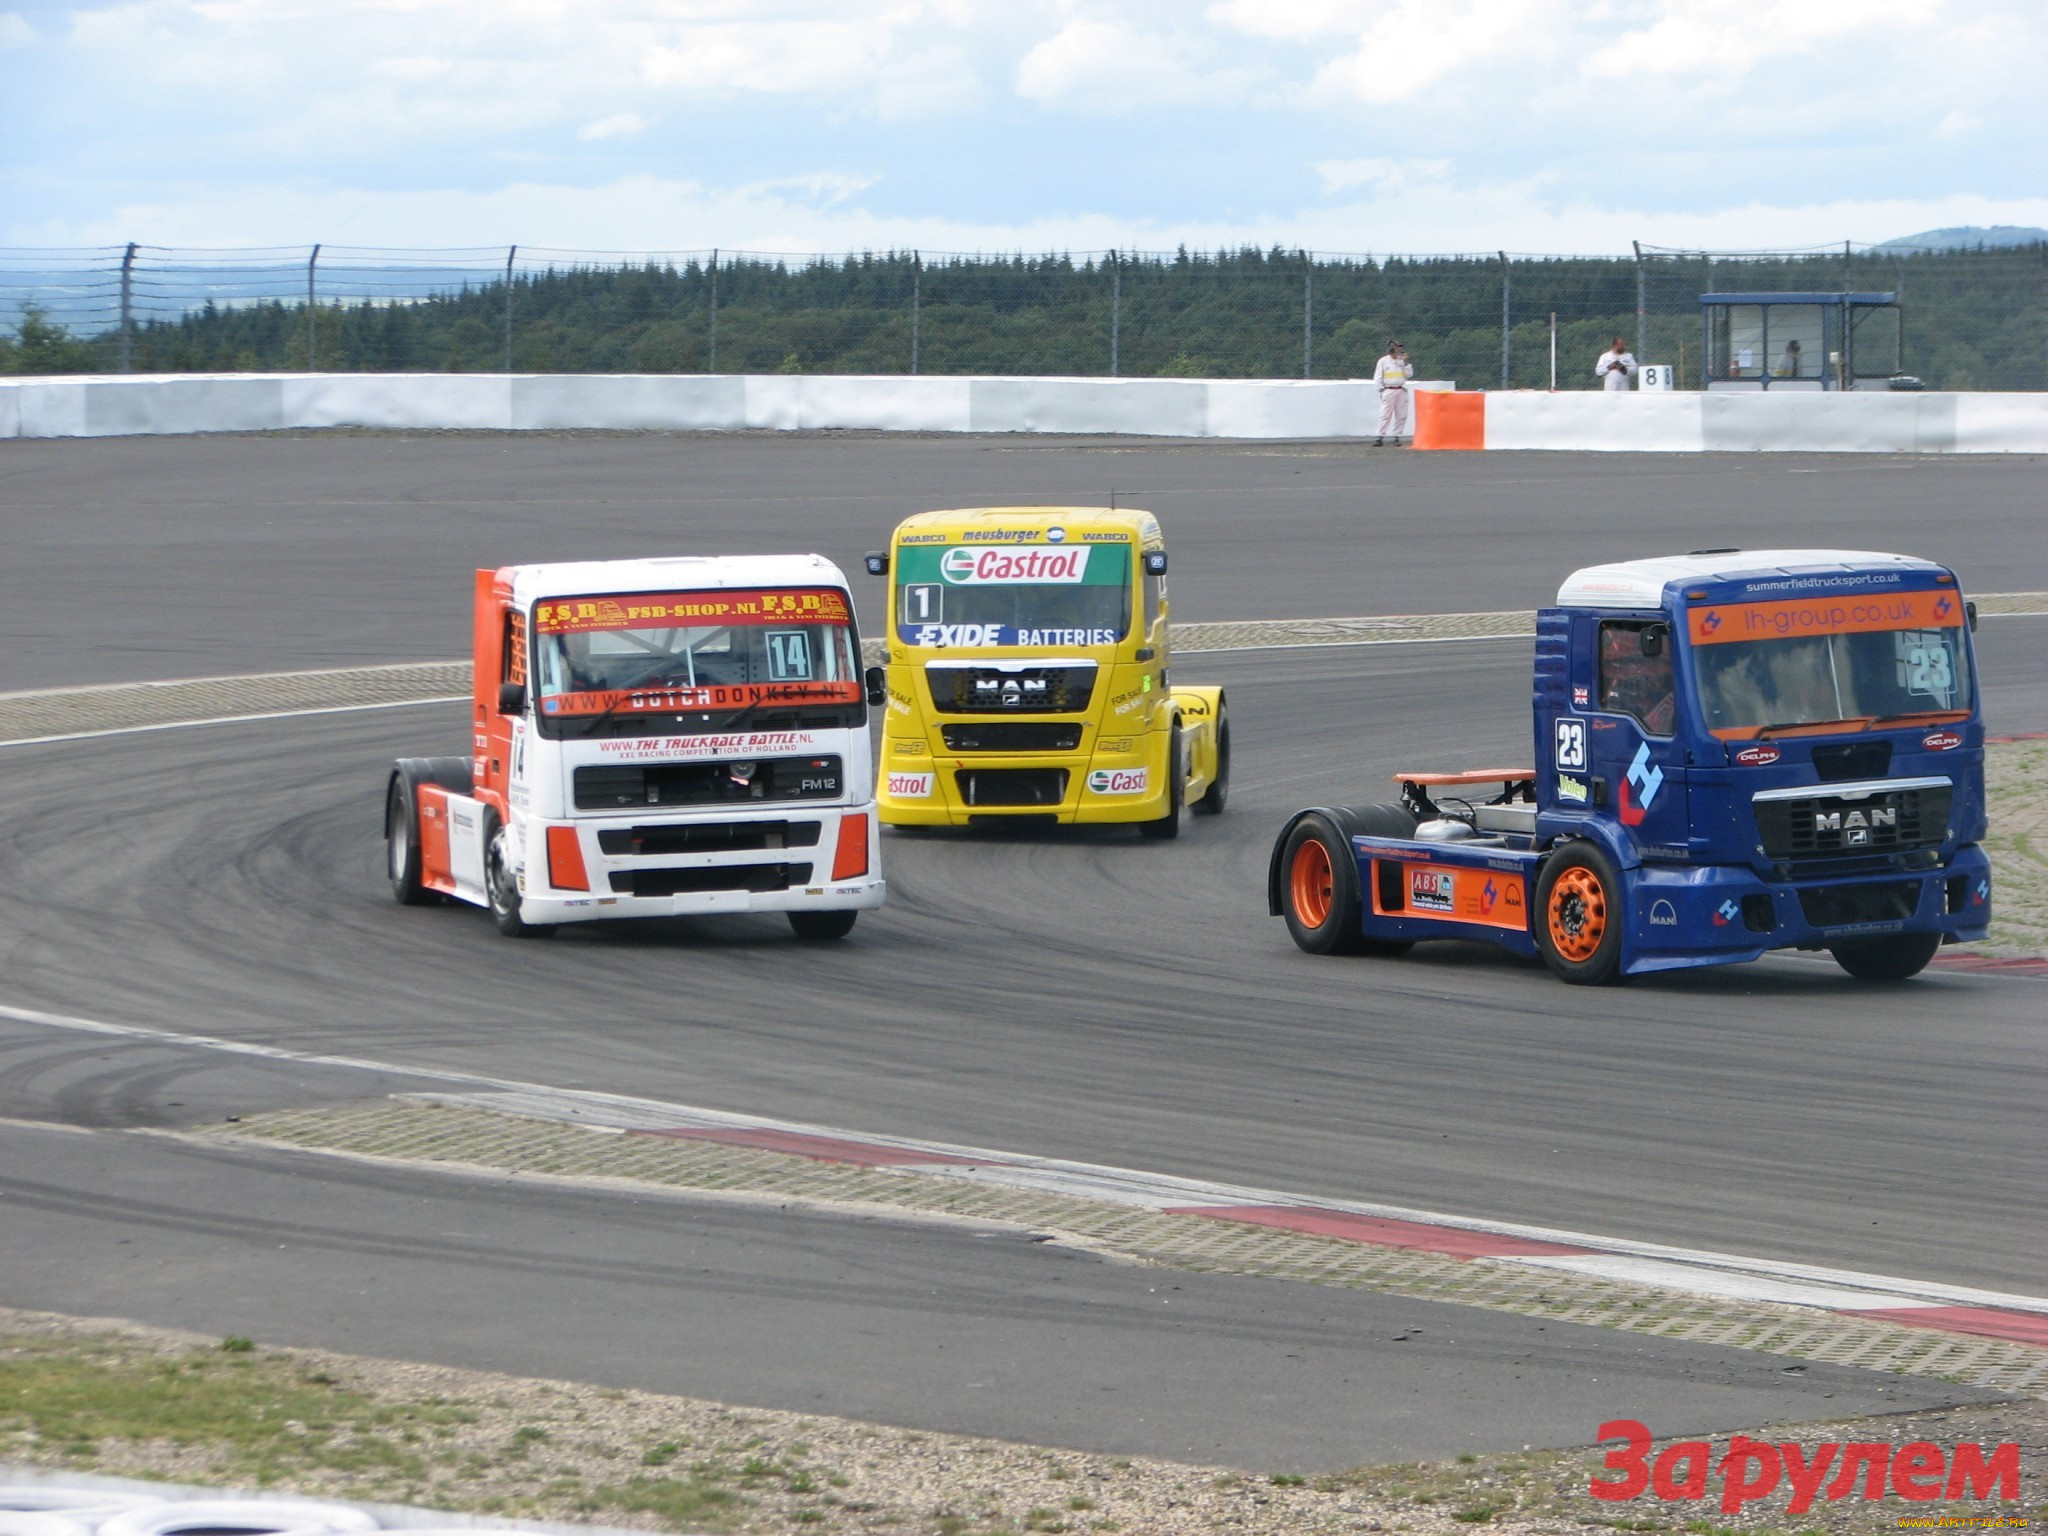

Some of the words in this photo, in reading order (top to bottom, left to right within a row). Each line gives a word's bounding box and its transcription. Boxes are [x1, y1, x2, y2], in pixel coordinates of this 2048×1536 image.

[1645, 368, 1657, 386] 8
[901, 534, 946, 543] WABCO
[962, 528, 1041, 542] meusburger
[1082, 533, 1129, 541] WABCO
[976, 550, 1080, 579] Castrol
[1745, 573, 1901, 592] summerfieldtrucksport.co.uk
[914, 587, 930, 618] 1
[916, 624, 1004, 646] EXIDE
[1017, 628, 1115, 646] BATTERIES
[771, 635, 807, 677] 14
[1910, 647, 1951, 689] 23
[976, 679, 1046, 694] MAN
[1112, 694, 1126, 705] FOR
[1180, 707, 1205, 715] AN
[638, 750, 672, 758] RACING
[742, 746, 753, 754] OF
[756, 744, 798, 752] HOLLAND
[1558, 724, 1584, 766] 23
[1926, 737, 1960, 747] DELPHI
[1740, 751, 1778, 762] DELPHI
[888, 776, 927, 794] astrol
[1110, 772, 1146, 791] Cast
[1559, 774, 1588, 799] Valeo
[1816, 808, 1896, 831] MAN
[1413, 873, 1437, 891] ABS
